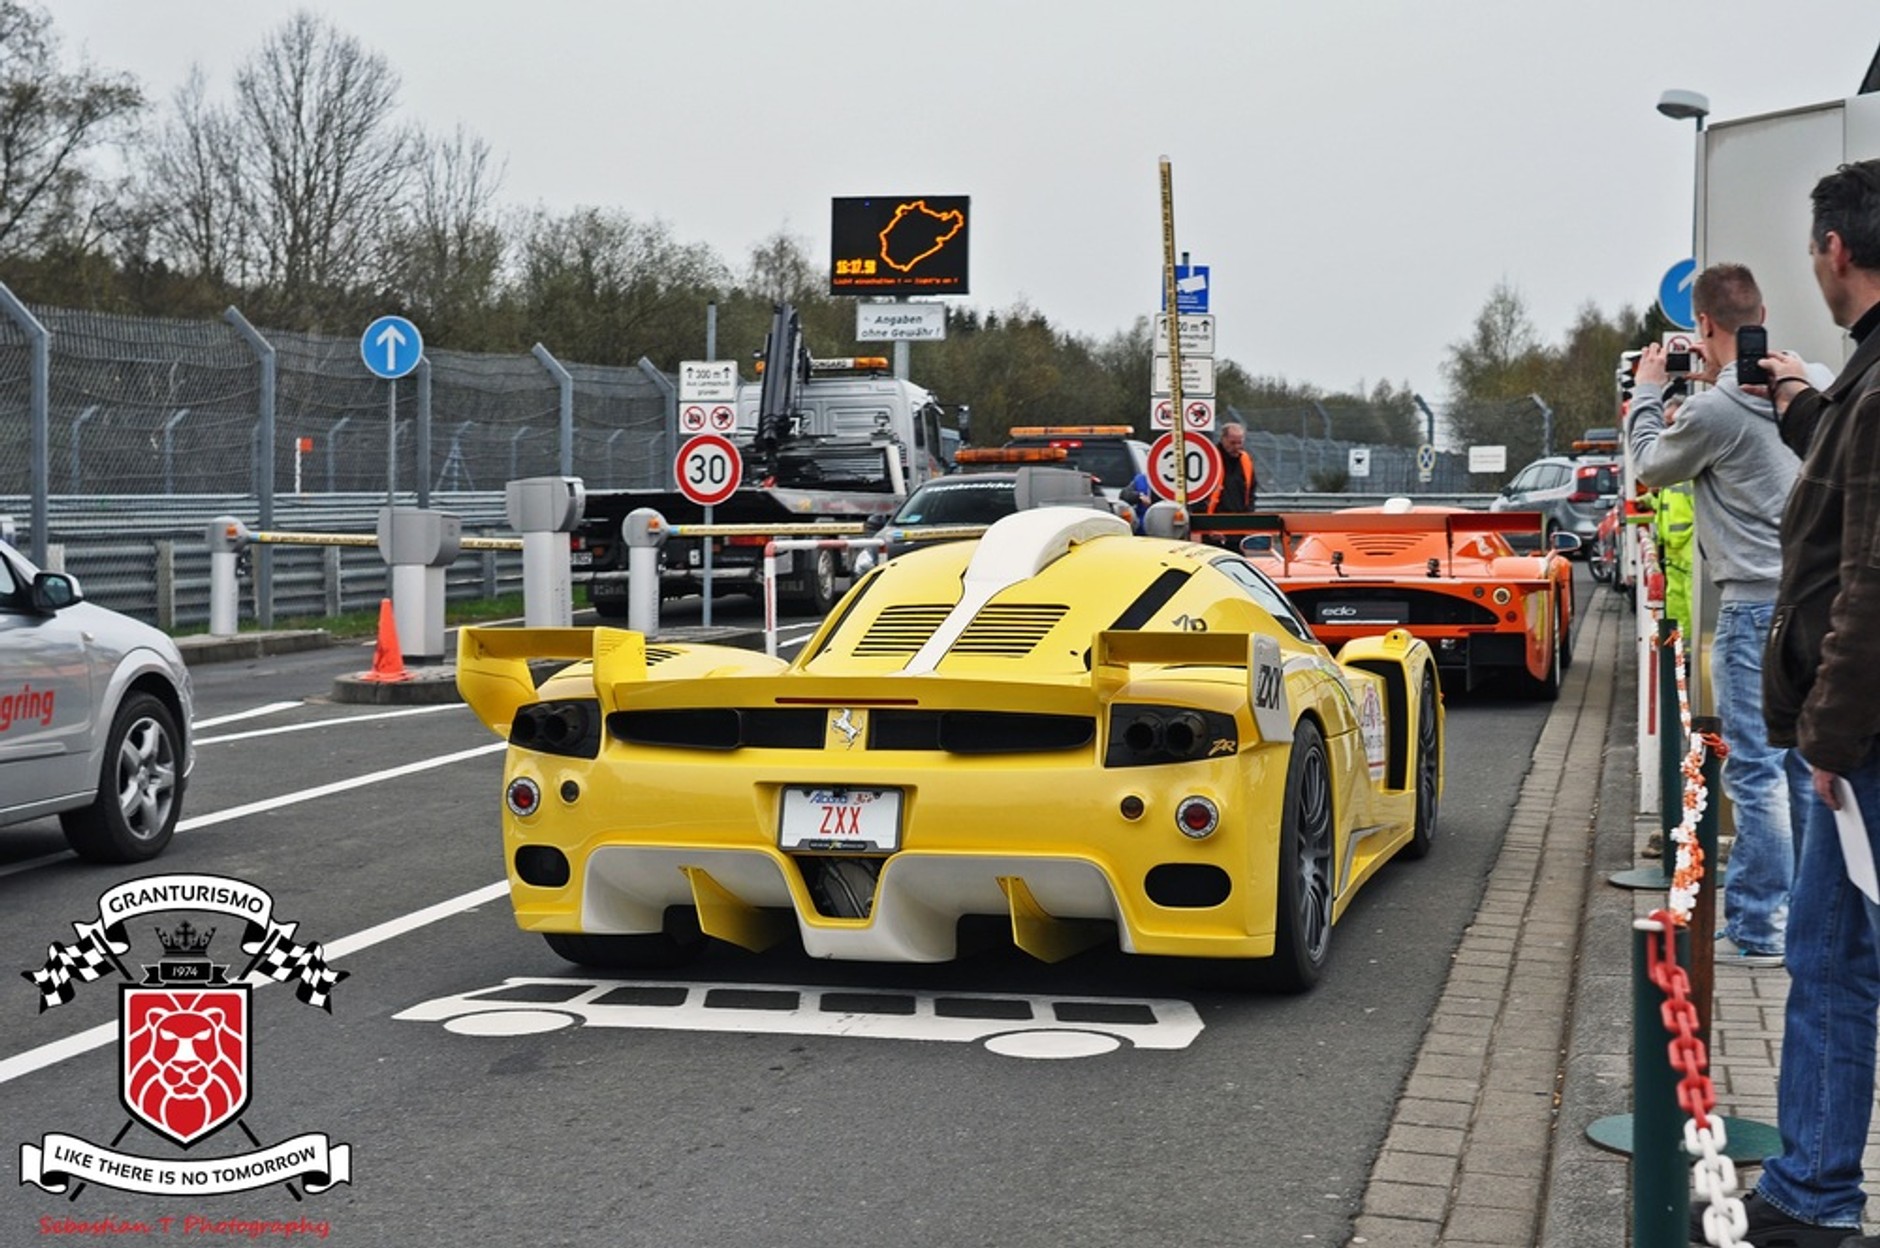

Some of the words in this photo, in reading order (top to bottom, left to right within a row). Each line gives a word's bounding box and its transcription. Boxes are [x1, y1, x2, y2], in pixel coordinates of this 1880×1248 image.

[874, 314, 923, 326] Angaben
[862, 328, 888, 338] ohne
[690, 454, 726, 484] 30
[1322, 606, 1356, 616] edo
[820, 806, 862, 834] ZXX
